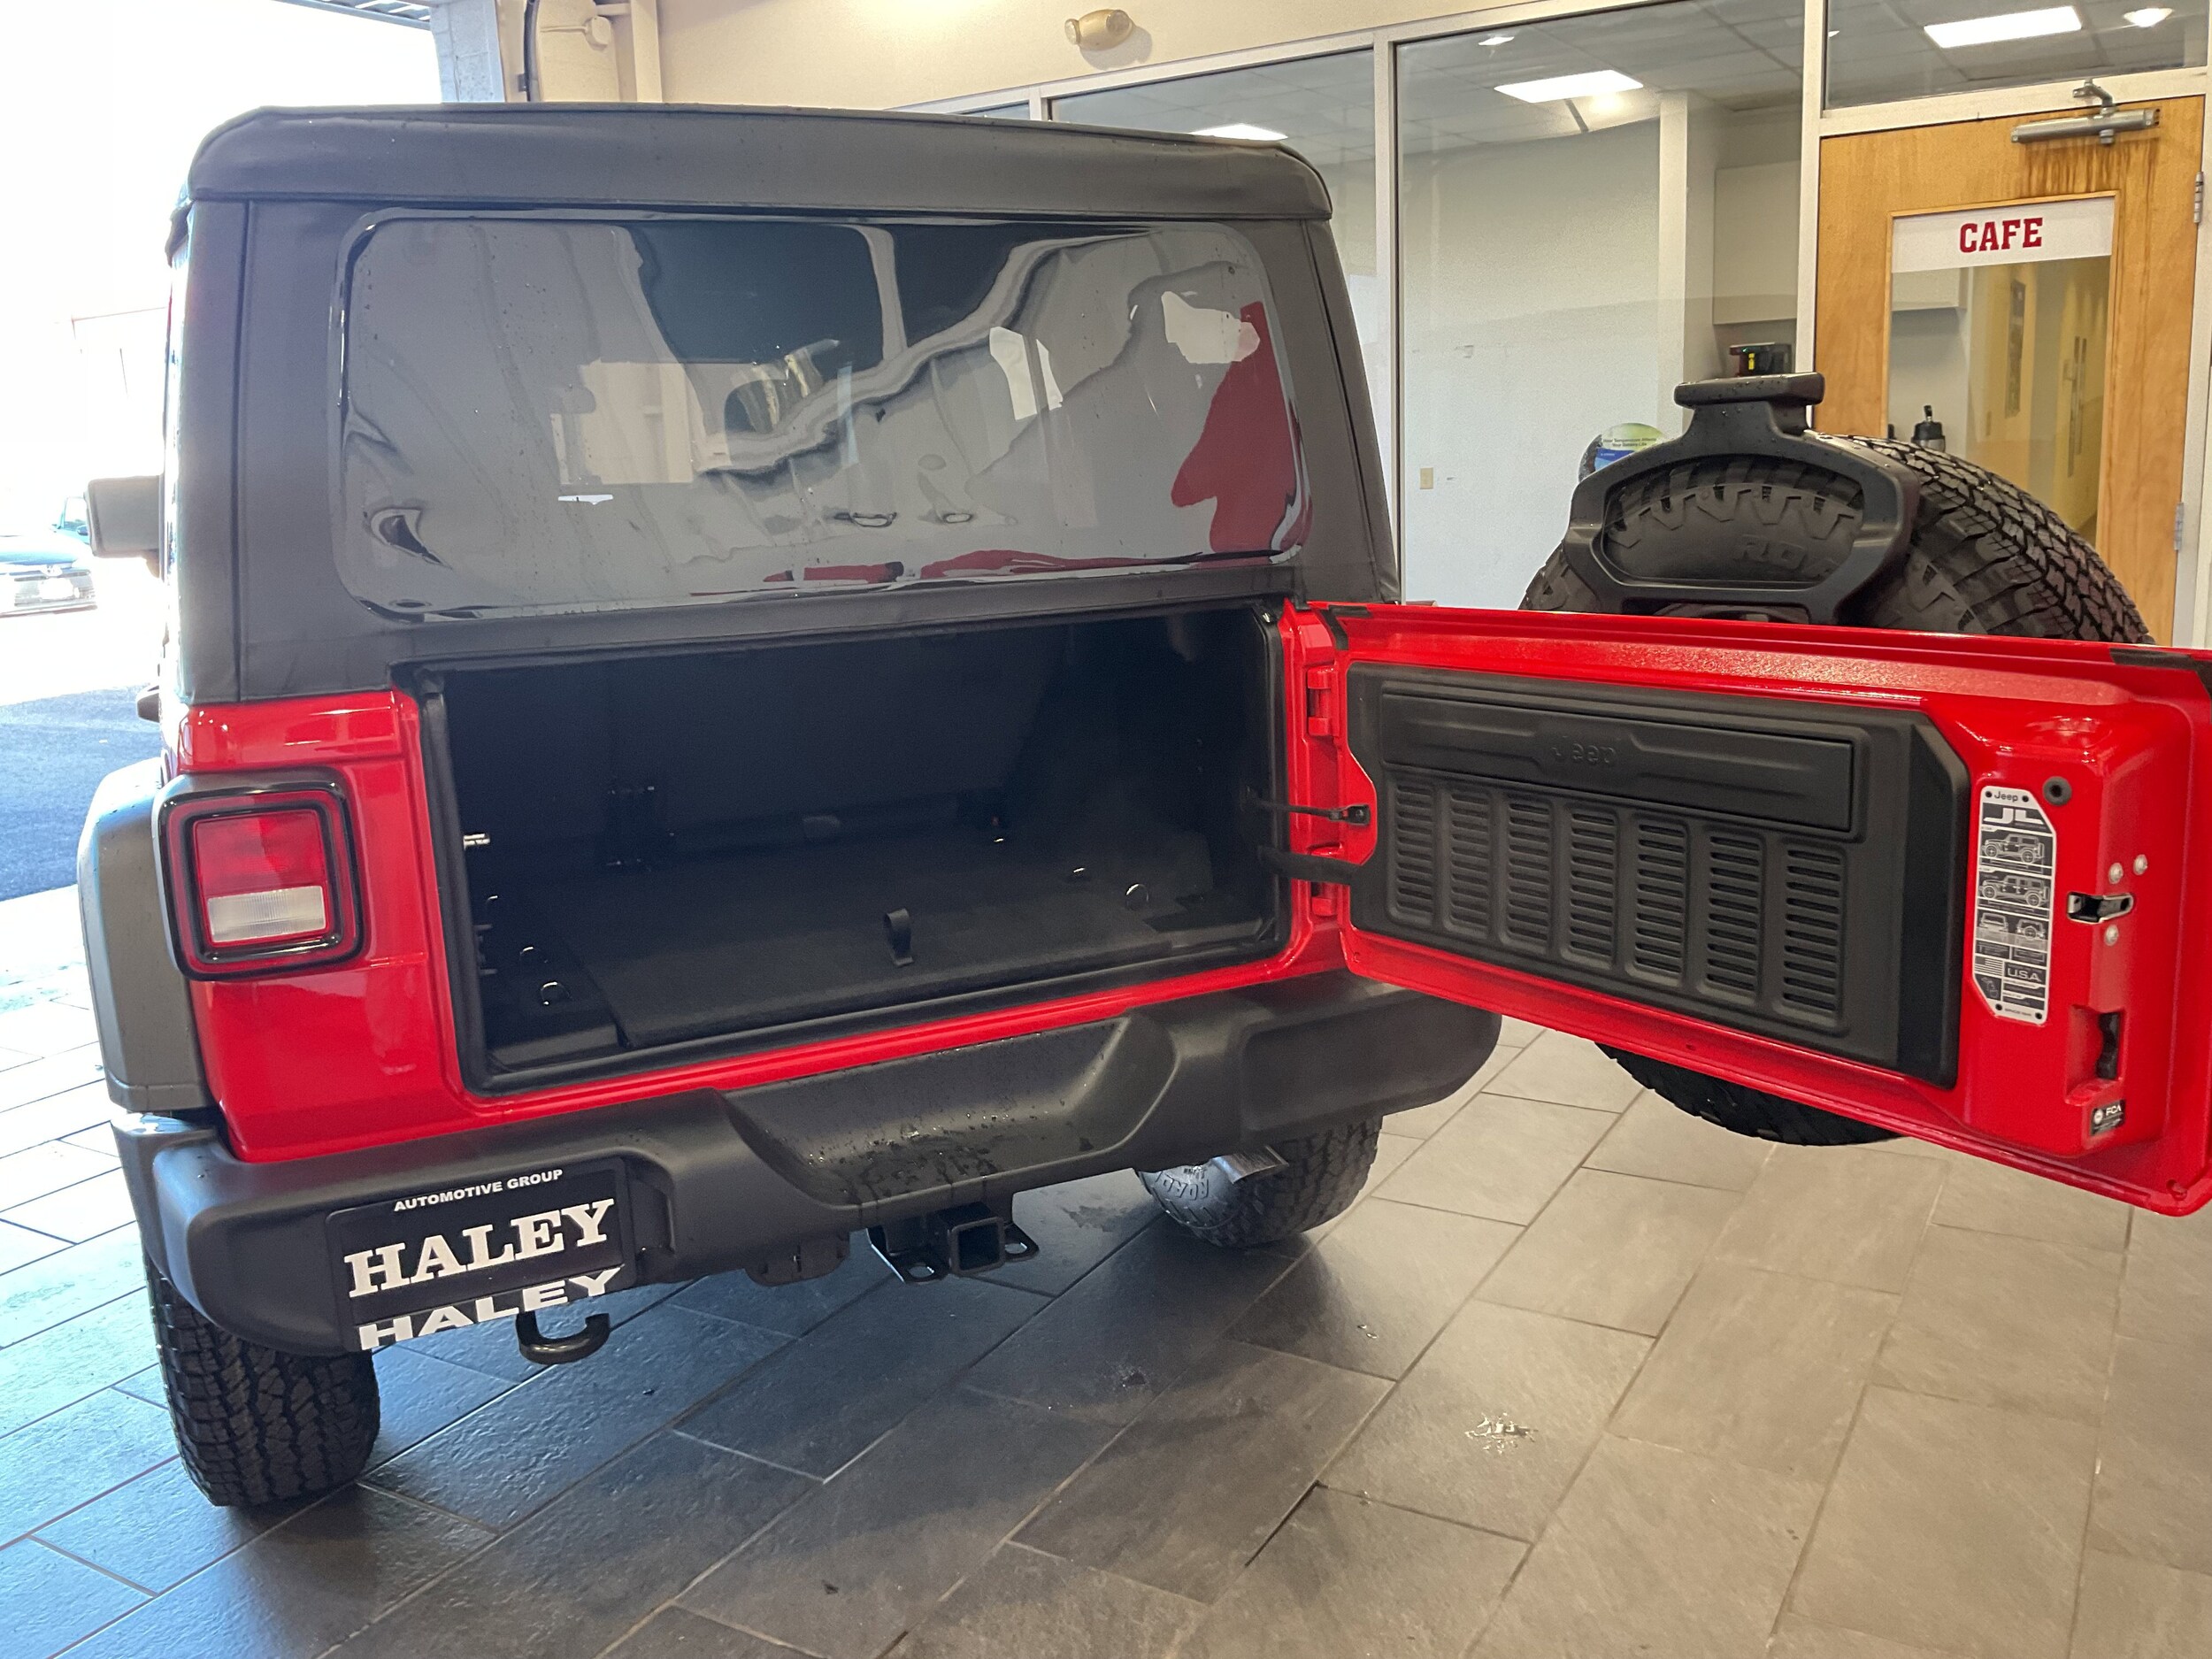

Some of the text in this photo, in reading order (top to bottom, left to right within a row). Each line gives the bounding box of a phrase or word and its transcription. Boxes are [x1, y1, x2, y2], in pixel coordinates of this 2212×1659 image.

[1959, 217, 2043, 253] CAFE
[1993, 791, 2019, 803] Jeep
[1983, 807, 2045, 826] JL
[2106, 1104, 2122, 1116] FCA
[394, 1169, 563, 1211] AUTOMOTIVE GROUP
[343, 1198, 615, 1298] HALEY
[358, 1267, 621, 1351] HALEY
